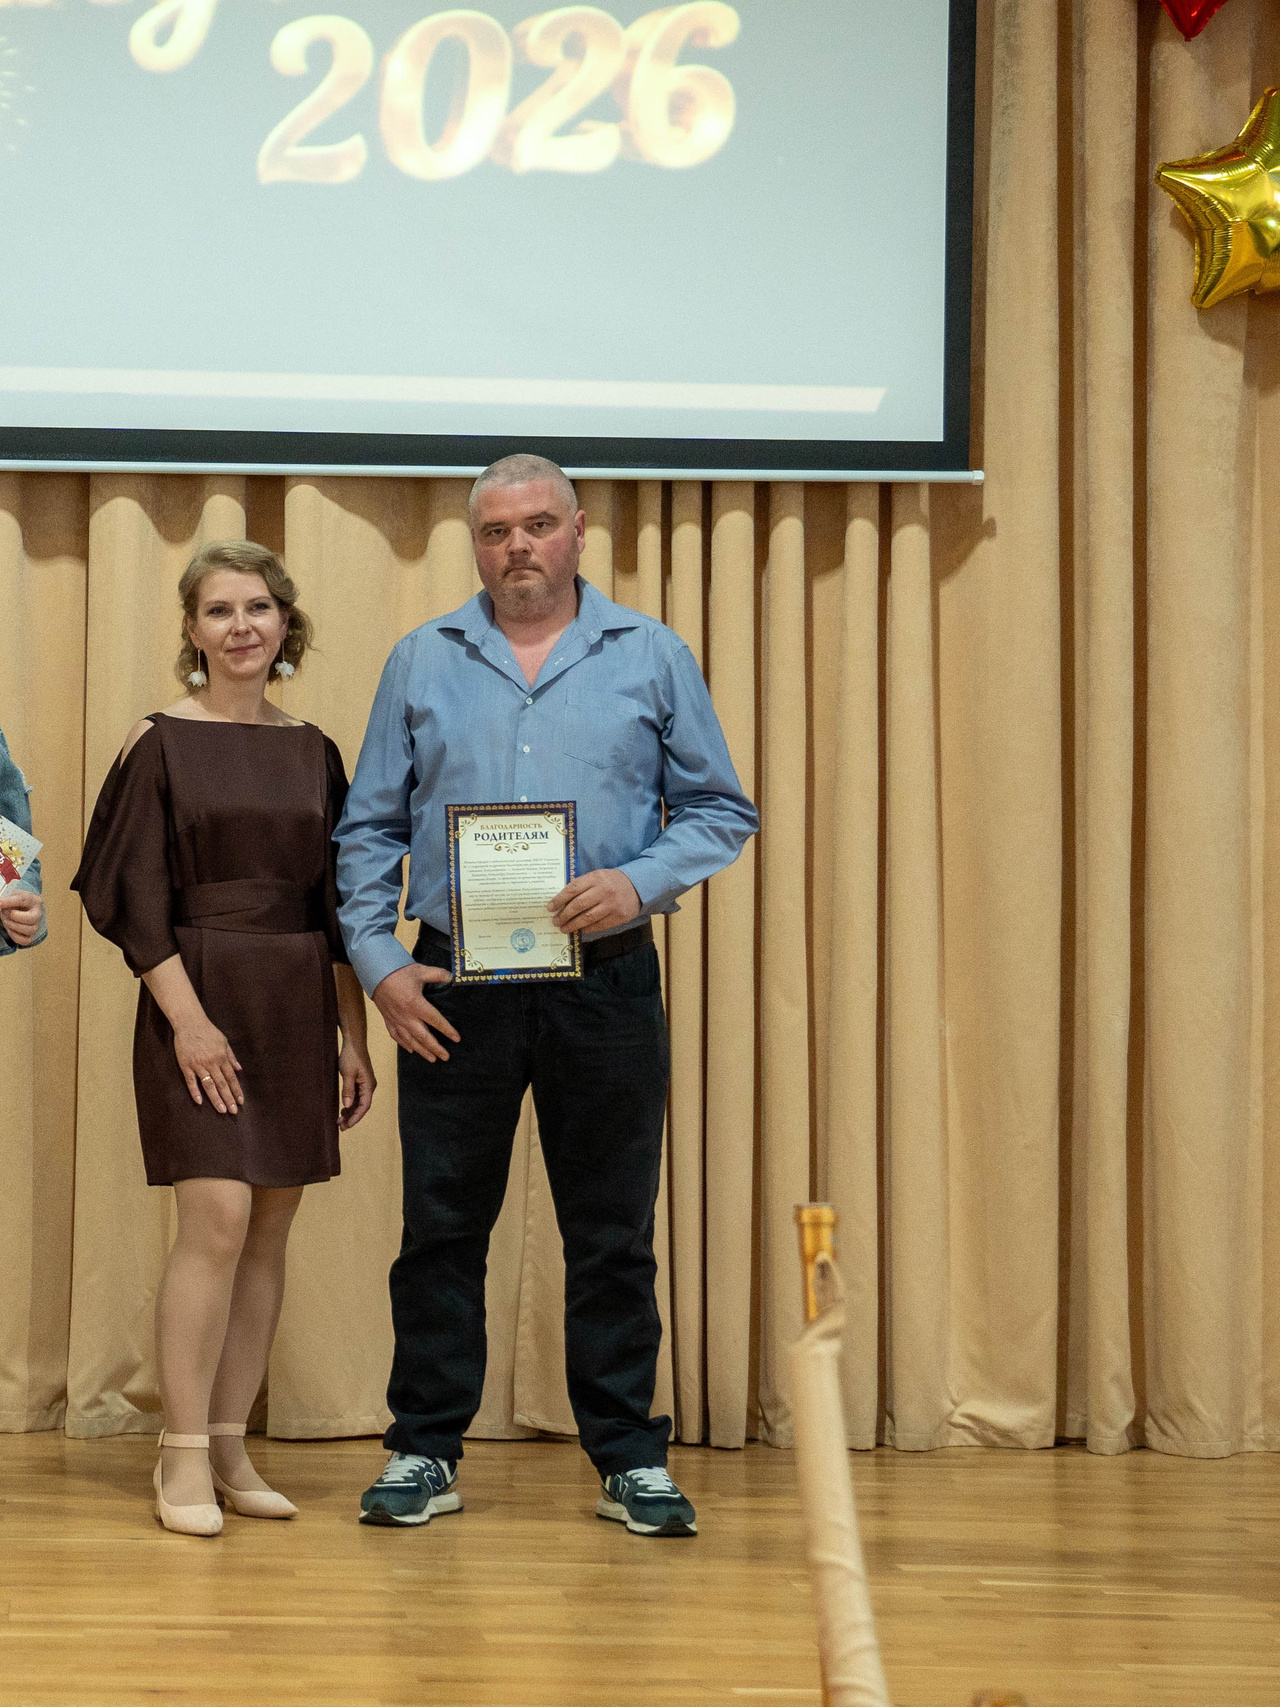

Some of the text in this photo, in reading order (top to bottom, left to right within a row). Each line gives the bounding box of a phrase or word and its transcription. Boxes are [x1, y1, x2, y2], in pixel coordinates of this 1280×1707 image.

[258, 0, 741, 184] 2026
[480, 823, 543, 831] БЛАГОДАРНОСТЬ
[474, 831, 549, 842] РОДИТЕЛЯМ
